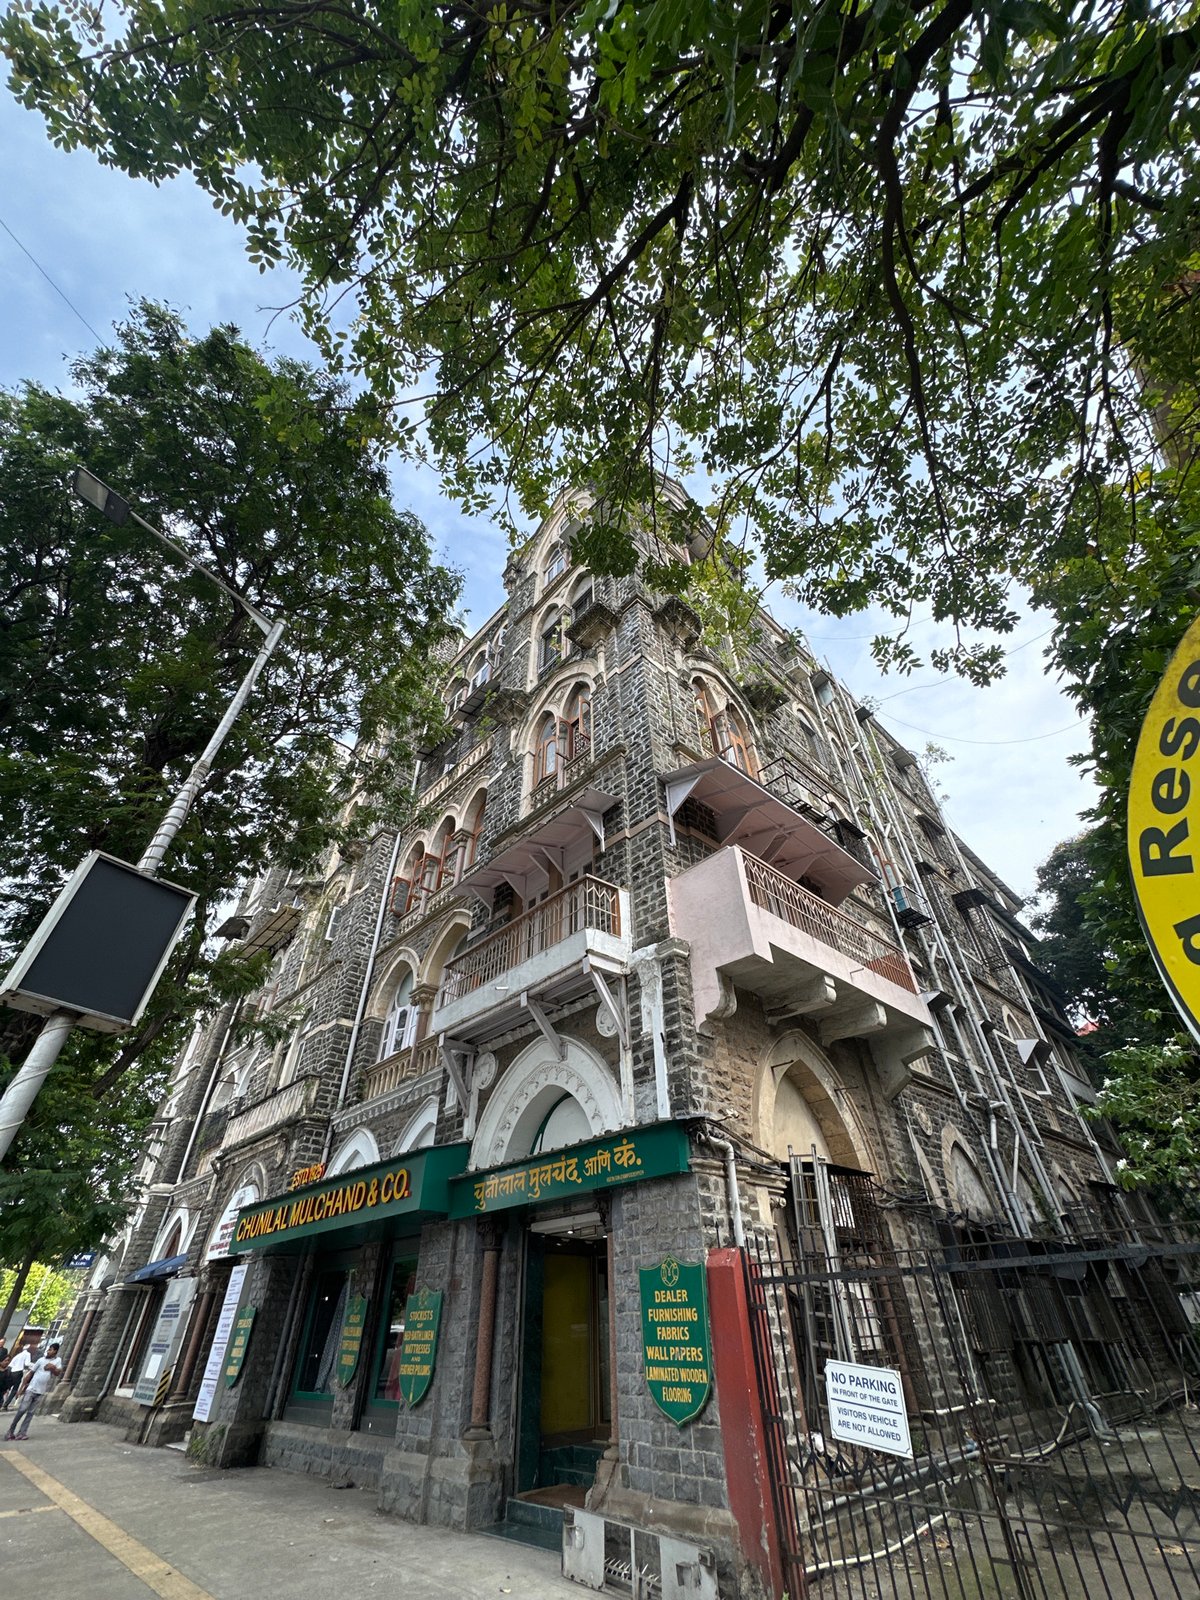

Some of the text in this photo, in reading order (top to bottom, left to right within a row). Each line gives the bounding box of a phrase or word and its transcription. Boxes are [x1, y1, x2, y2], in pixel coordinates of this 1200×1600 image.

[474, 1171, 527, 1210] चुनीलाल
[583, 1150, 611, 1177] आणि
[236, 1205, 288, 1242] CHUNILAL
[289, 1181, 366, 1228] MULCHAND
[367, 1178, 378, 1207] &
[381, 1168, 410, 1203] CO.
[654, 1290, 688, 1303] DEALER
[648, 1308, 698, 1322] FURNISHING
[656, 1326, 689, 1341] FABRICS
[646, 1346, 703, 1361] WALL PAPERS
[646, 1366, 708, 1384] LAMINATED WOODEN
[831, 1371, 897, 1394] NO PARKING
[662, 1386, 692, 1403] FLOORING
[840, 1389, 858, 1398] FRONT
[859, 1392, 867, 1400] OF
[868, 1395, 880, 1403] THE
[882, 1398, 898, 1407] GATE
[837, 1406, 898, 1428] VISITORS VEHICLE
[838, 1420, 901, 1441] ARE NOT ALLOWED
